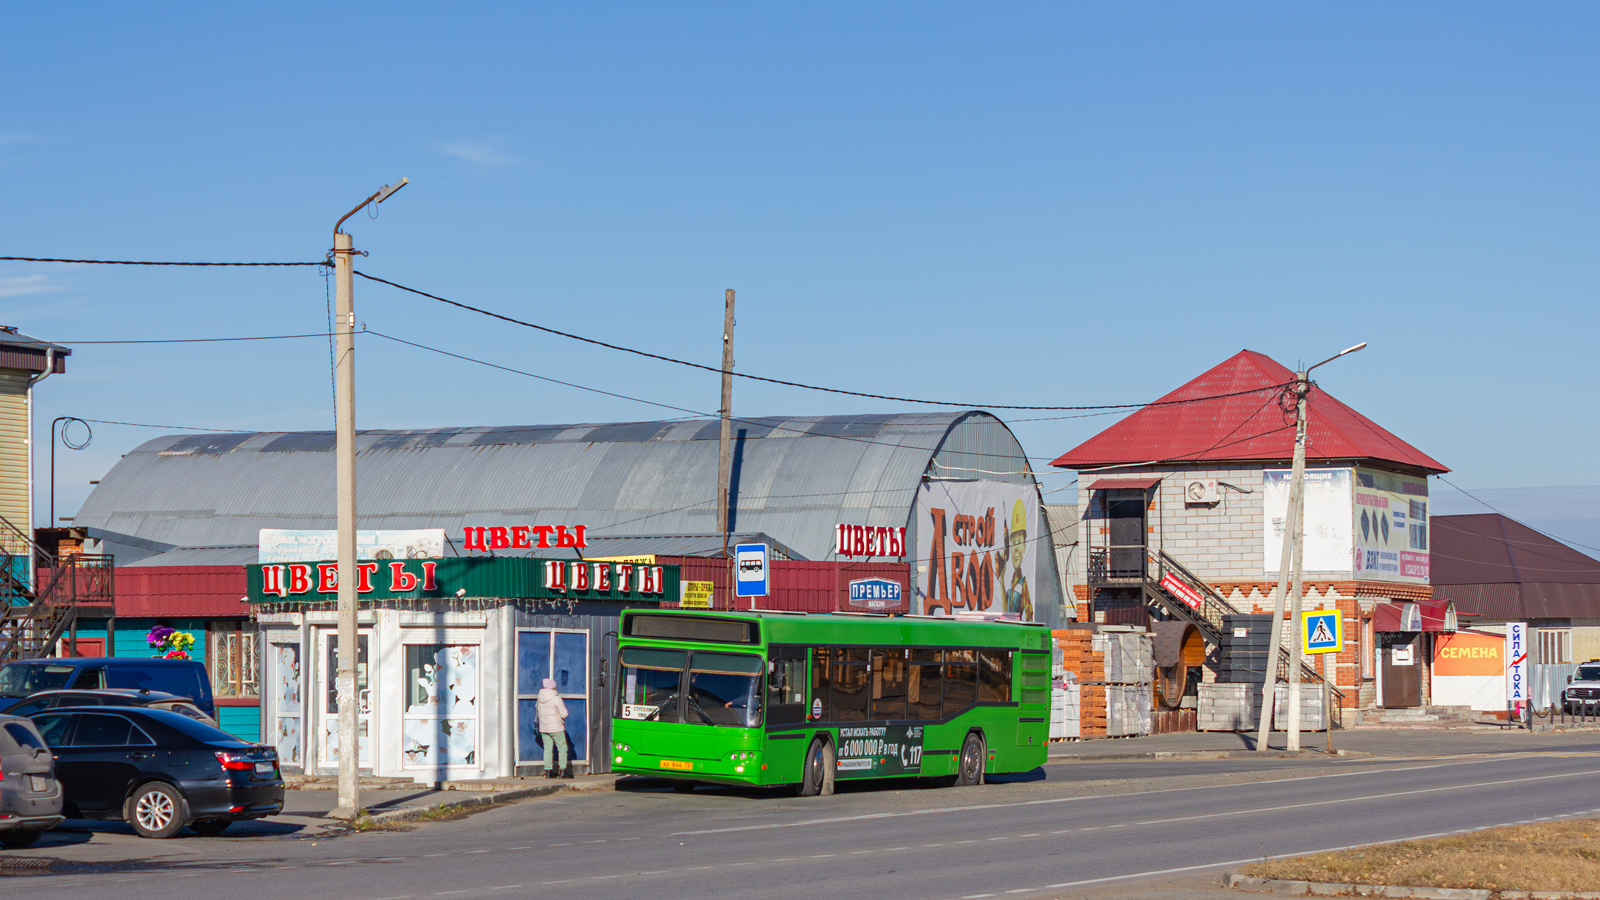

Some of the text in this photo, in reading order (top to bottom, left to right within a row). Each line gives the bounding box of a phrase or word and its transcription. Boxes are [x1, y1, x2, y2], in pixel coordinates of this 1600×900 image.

[1283, 472, 1332, 480] НАОЯЩИЕ
[463, 524, 589, 552] ЦВЕТЫ
[834, 523, 907, 560] ЦВЕТЫ
[952, 507, 996, 548] СТРОЙ
[923, 507, 994, 615] ДВОР
[261, 561, 438, 598] ЦВЕТЫ
[545, 561, 664, 594] ЦВЕТЫ
[852, 584, 899, 598] ПРЕМЬЕР
[1440, 647, 1498, 659] СЕМЕНА
[1512, 624, 1521, 658] СИЛА
[1512, 665, 1521, 698] ТОКА
[624, 706, 631, 717] 5
[839, 727, 887, 737] УСТАЛ ИСКАТЬ РАБОТУ?
[844, 740, 849, 757] 6
[849, 739, 864, 756] 000
[864, 739, 878, 756] 000
[883, 744, 888, 755] в
[887, 743, 898, 756] год
[909, 746, 922, 765] 117
